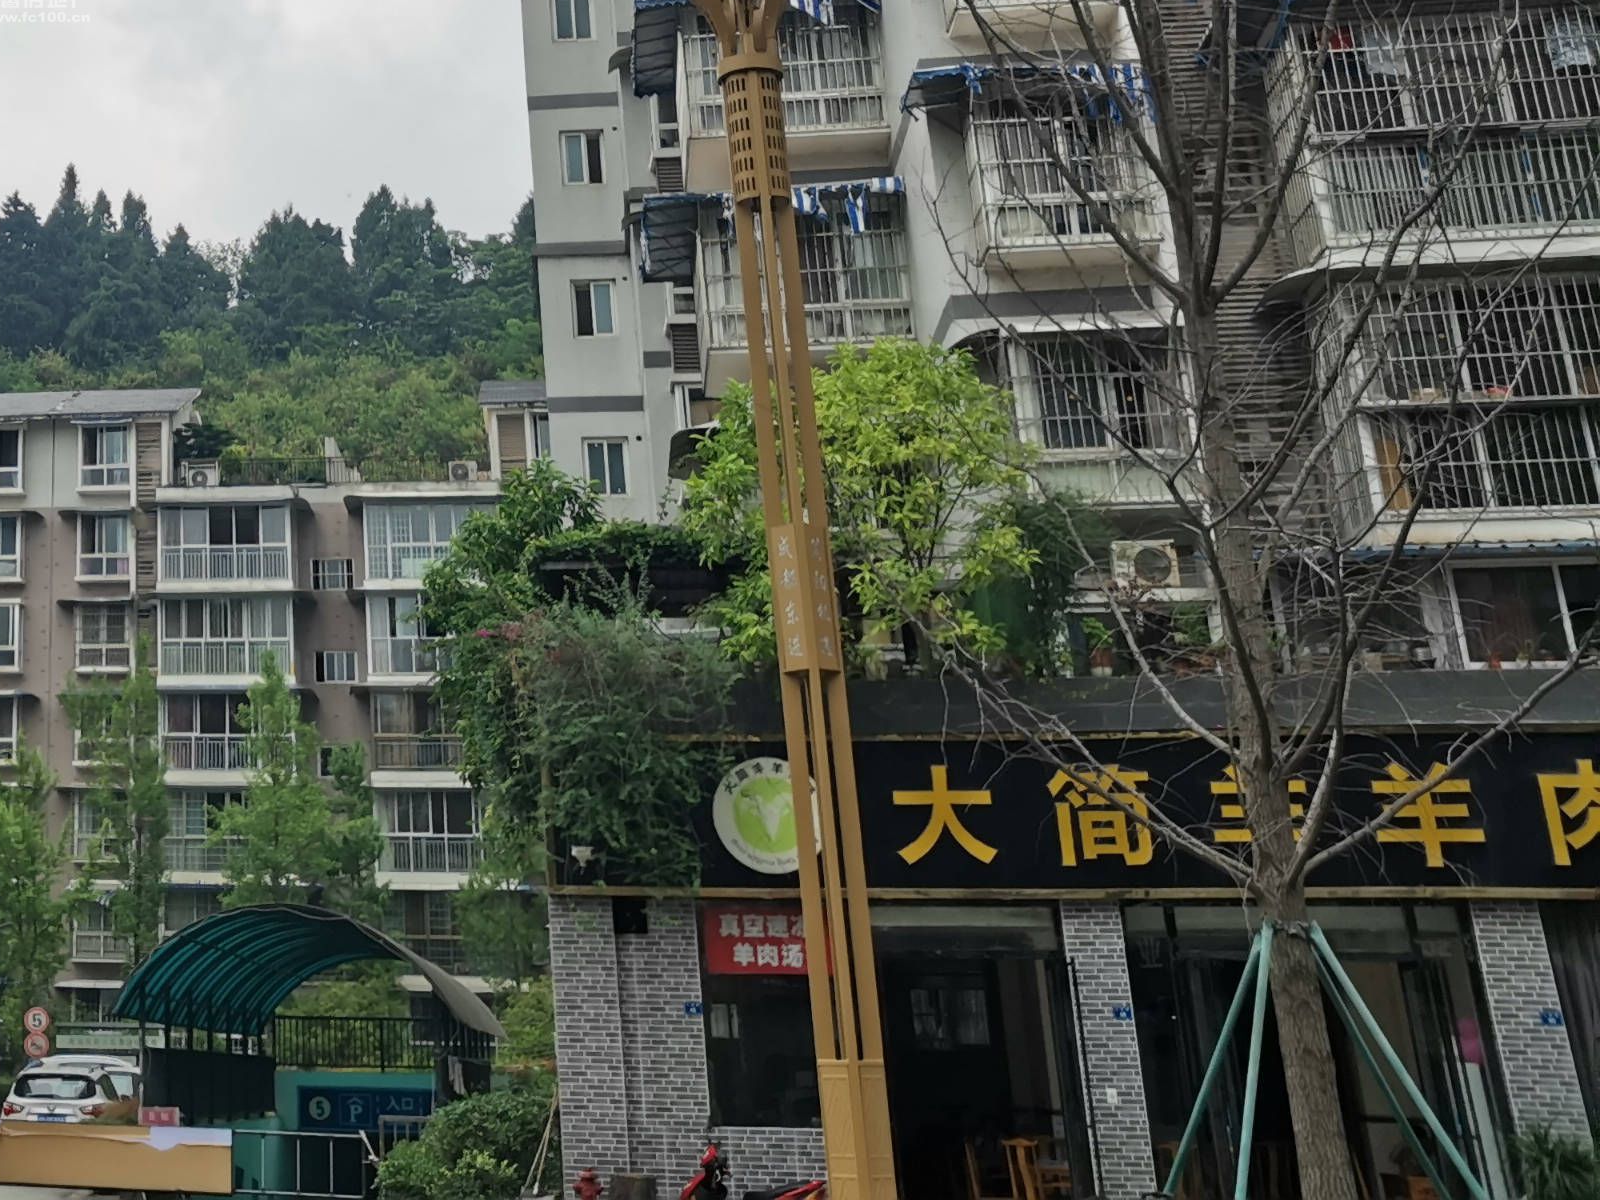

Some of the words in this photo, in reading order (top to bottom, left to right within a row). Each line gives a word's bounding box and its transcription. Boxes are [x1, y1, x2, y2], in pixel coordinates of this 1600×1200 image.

[732, 942, 804, 968] 羊肉汤
[386, 1096, 414, 1111] 入口
